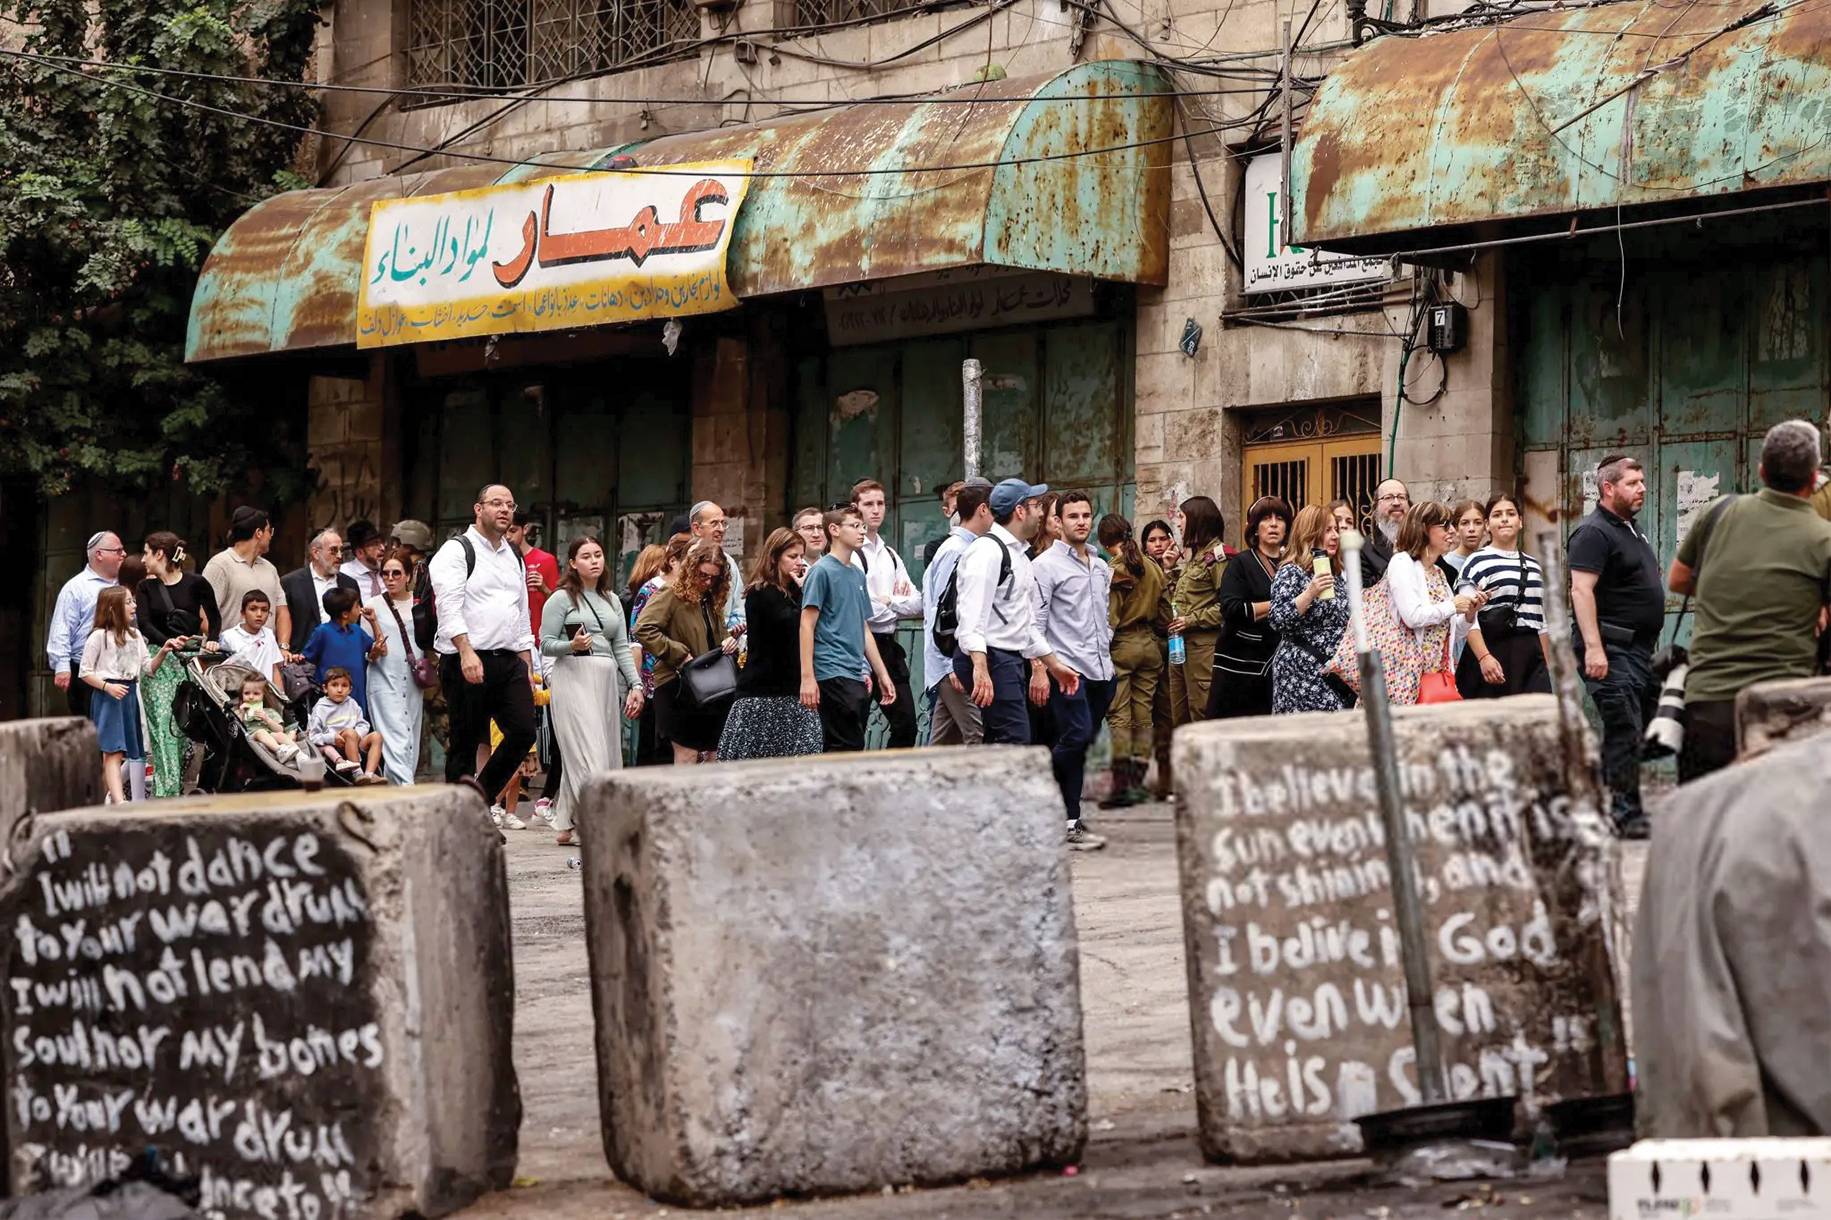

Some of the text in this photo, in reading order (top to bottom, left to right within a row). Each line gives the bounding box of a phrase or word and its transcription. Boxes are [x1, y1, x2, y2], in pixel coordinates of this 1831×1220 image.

[371, 178, 729, 289] عمار لمواد البناء
[1284, 261, 1307, 280] حقوق
[698, 270, 720, 302] لوازم
[1436, 312, 1444, 325] 7
[1210, 743, 1517, 817] I believe in the
[1286, 817, 1368, 858] even
[38, 833, 326, 917] I will not dance
[1206, 866, 1269, 916] not
[1442, 841, 1538, 889] and
[15, 914, 61, 965] to
[149, 889, 261, 943] war
[1211, 924, 1238, 975] I
[1437, 897, 1558, 967] God
[10, 976, 33, 1015] I
[35, 968, 101, 1010] will
[103, 945, 188, 1011] not
[191, 937, 297, 995] lend
[1209, 977, 1497, 1048] even wen
[91, 1025, 171, 1071] nor
[252, 1012, 384, 1078] bones
[1224, 1056, 1288, 1118] He
[1285, 1038, 1332, 1117] is
[15, 1074, 52, 1133] to
[134, 1096, 236, 1145] war
